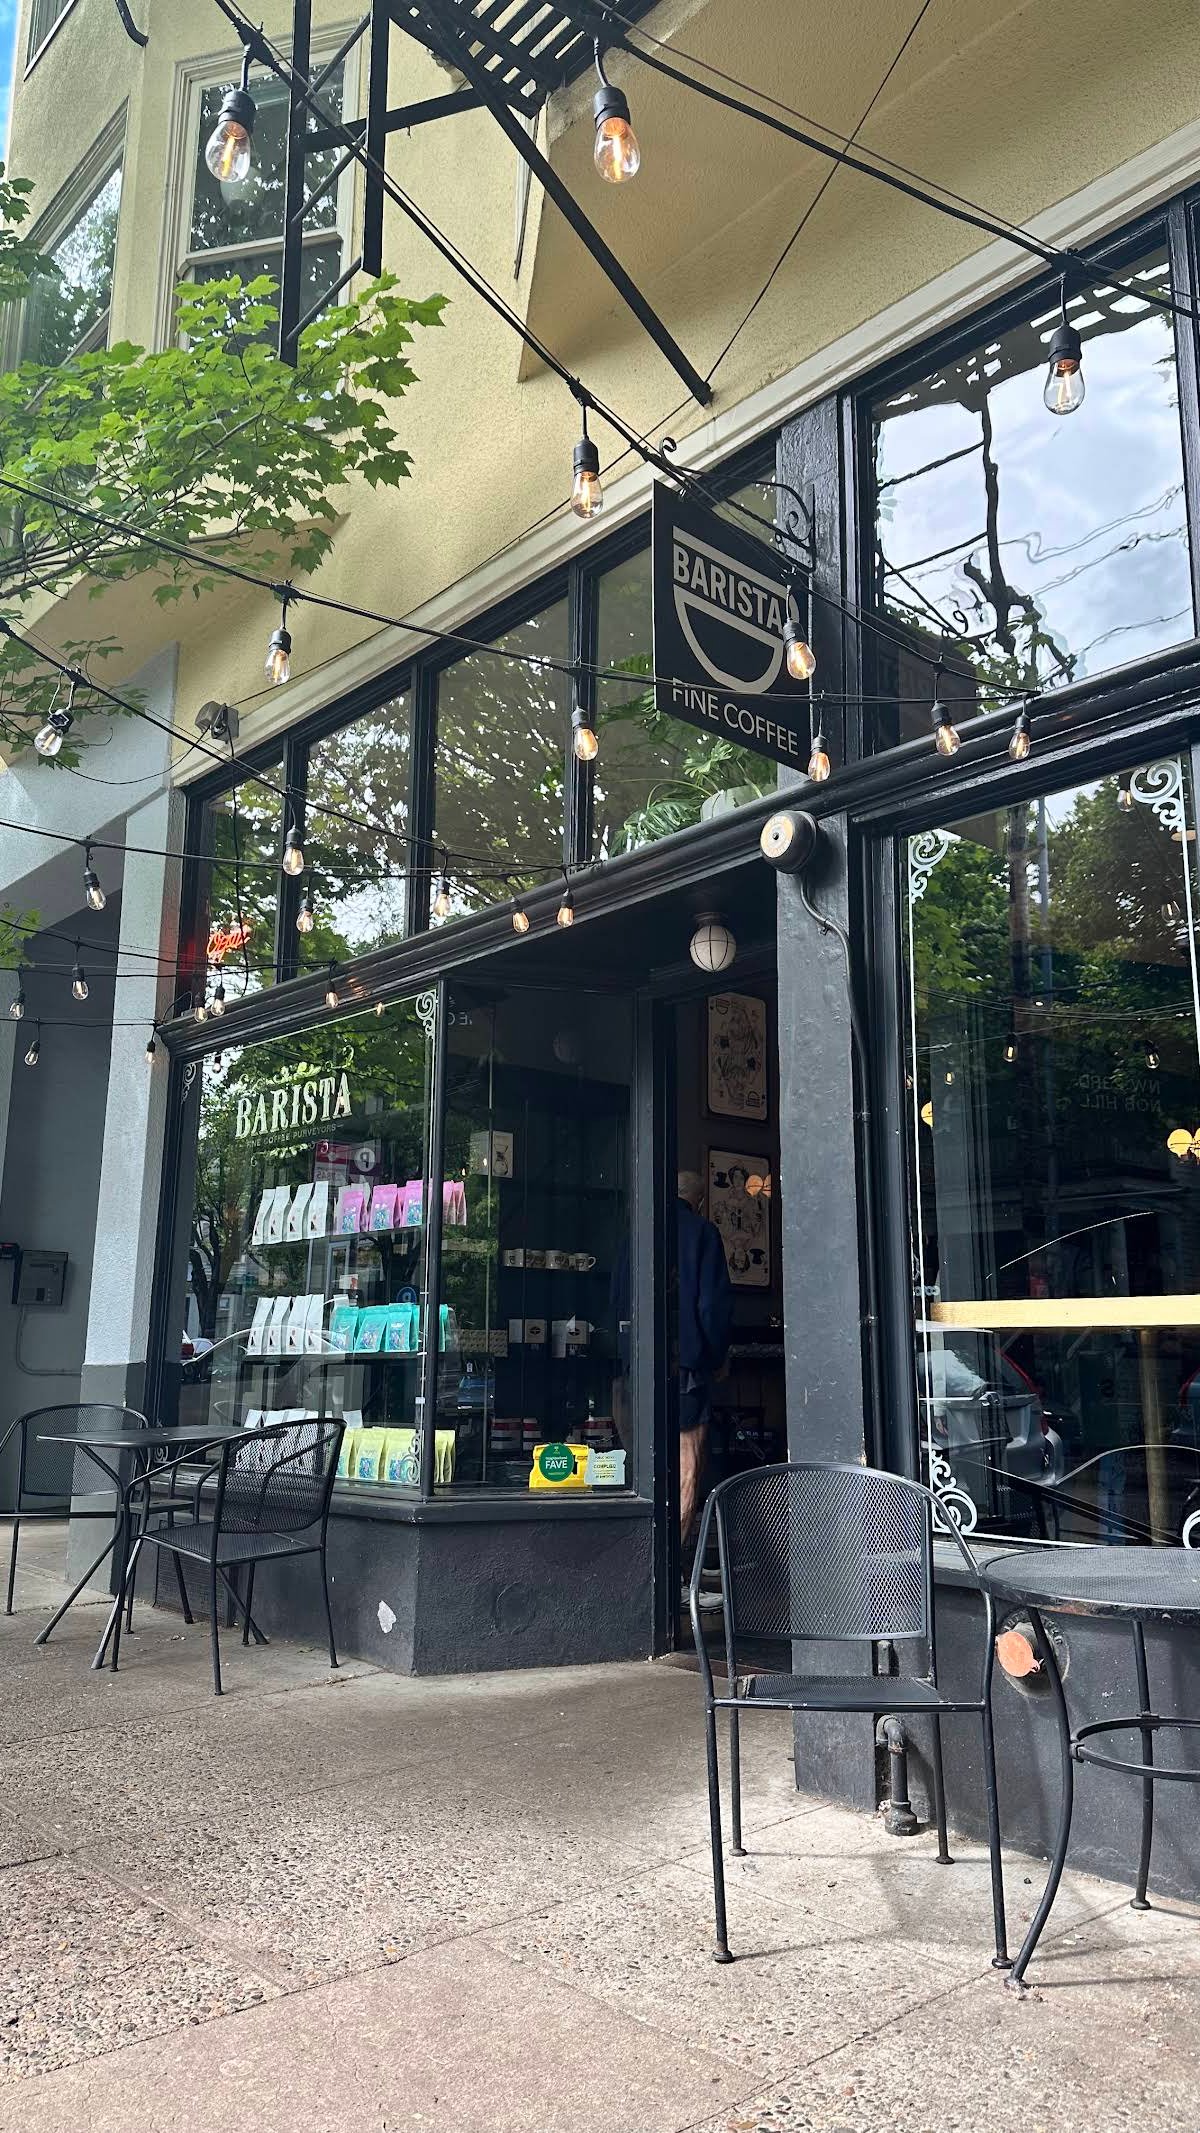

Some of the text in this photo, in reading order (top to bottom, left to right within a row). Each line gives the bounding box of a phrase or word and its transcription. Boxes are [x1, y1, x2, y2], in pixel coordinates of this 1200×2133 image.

[673, 543, 784, 634] BARISTA
[672, 677, 799, 756] FINE COFFEE
[235, 1072, 353, 1140] BARISTA
[545, 1460, 568, 1470] FAVE
